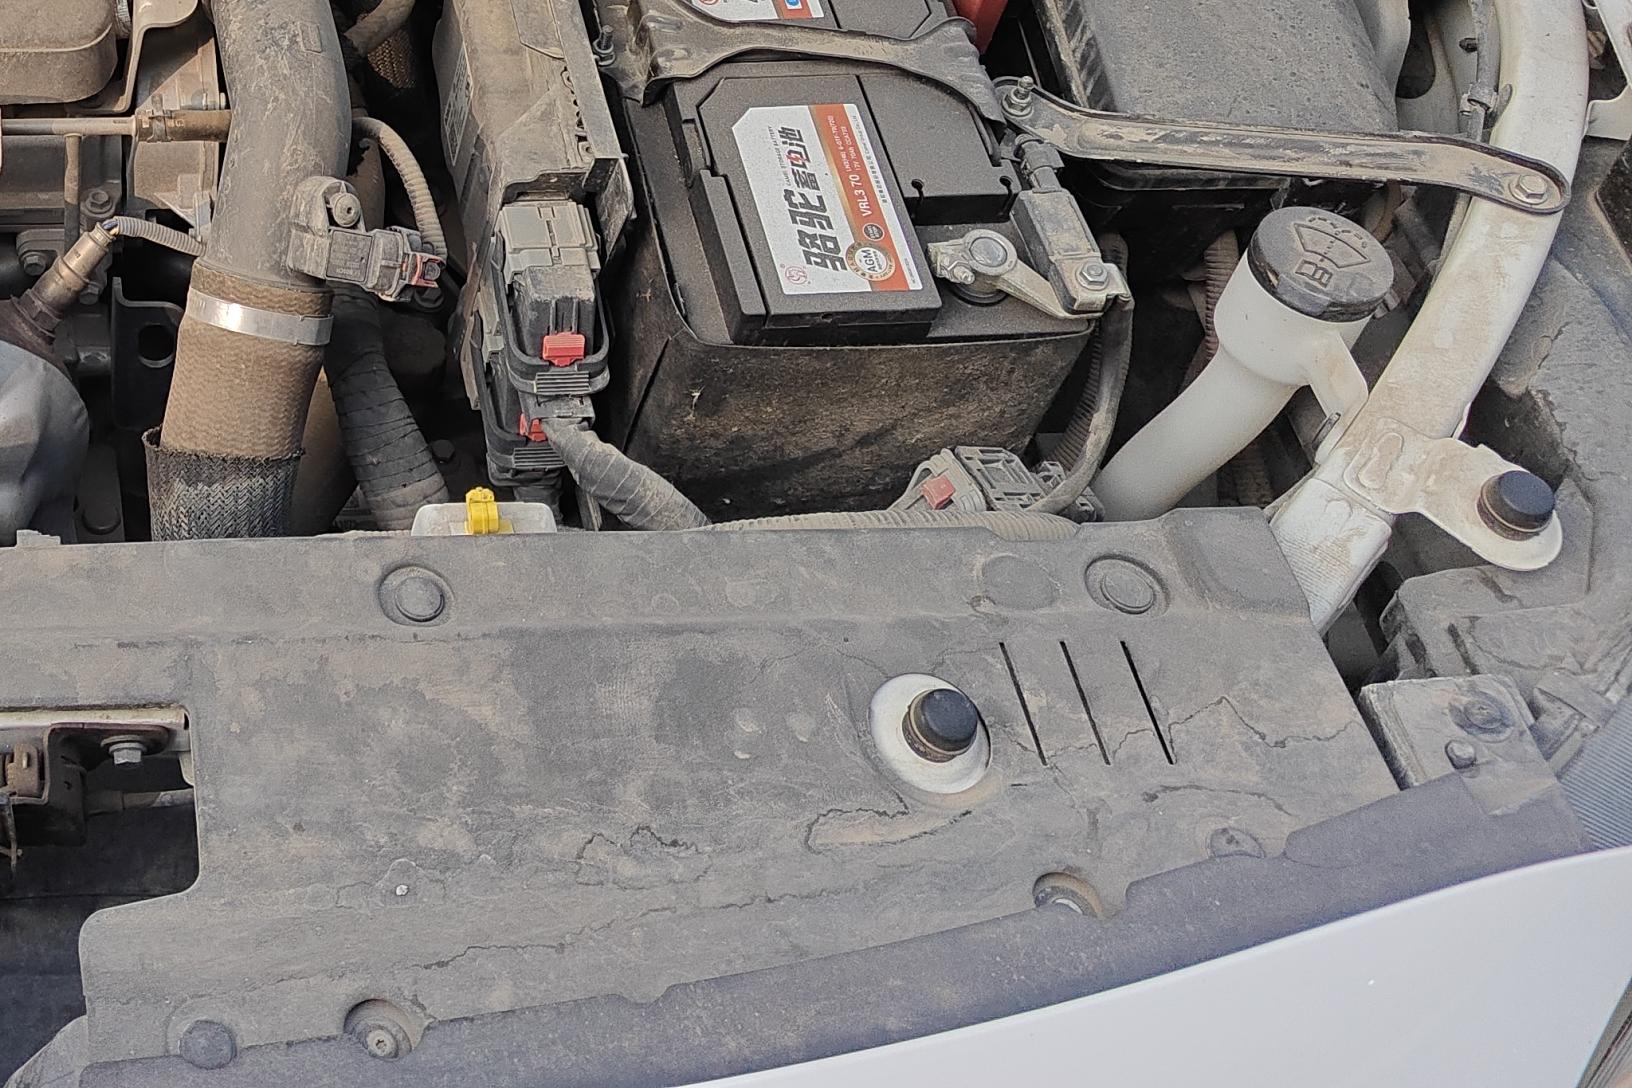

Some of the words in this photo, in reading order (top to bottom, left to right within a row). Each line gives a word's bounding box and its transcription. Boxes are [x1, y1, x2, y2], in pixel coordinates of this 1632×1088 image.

[849, 175, 862, 186] 70
[855, 189, 873, 216] VRL3
[864, 249, 877, 272] AGM
